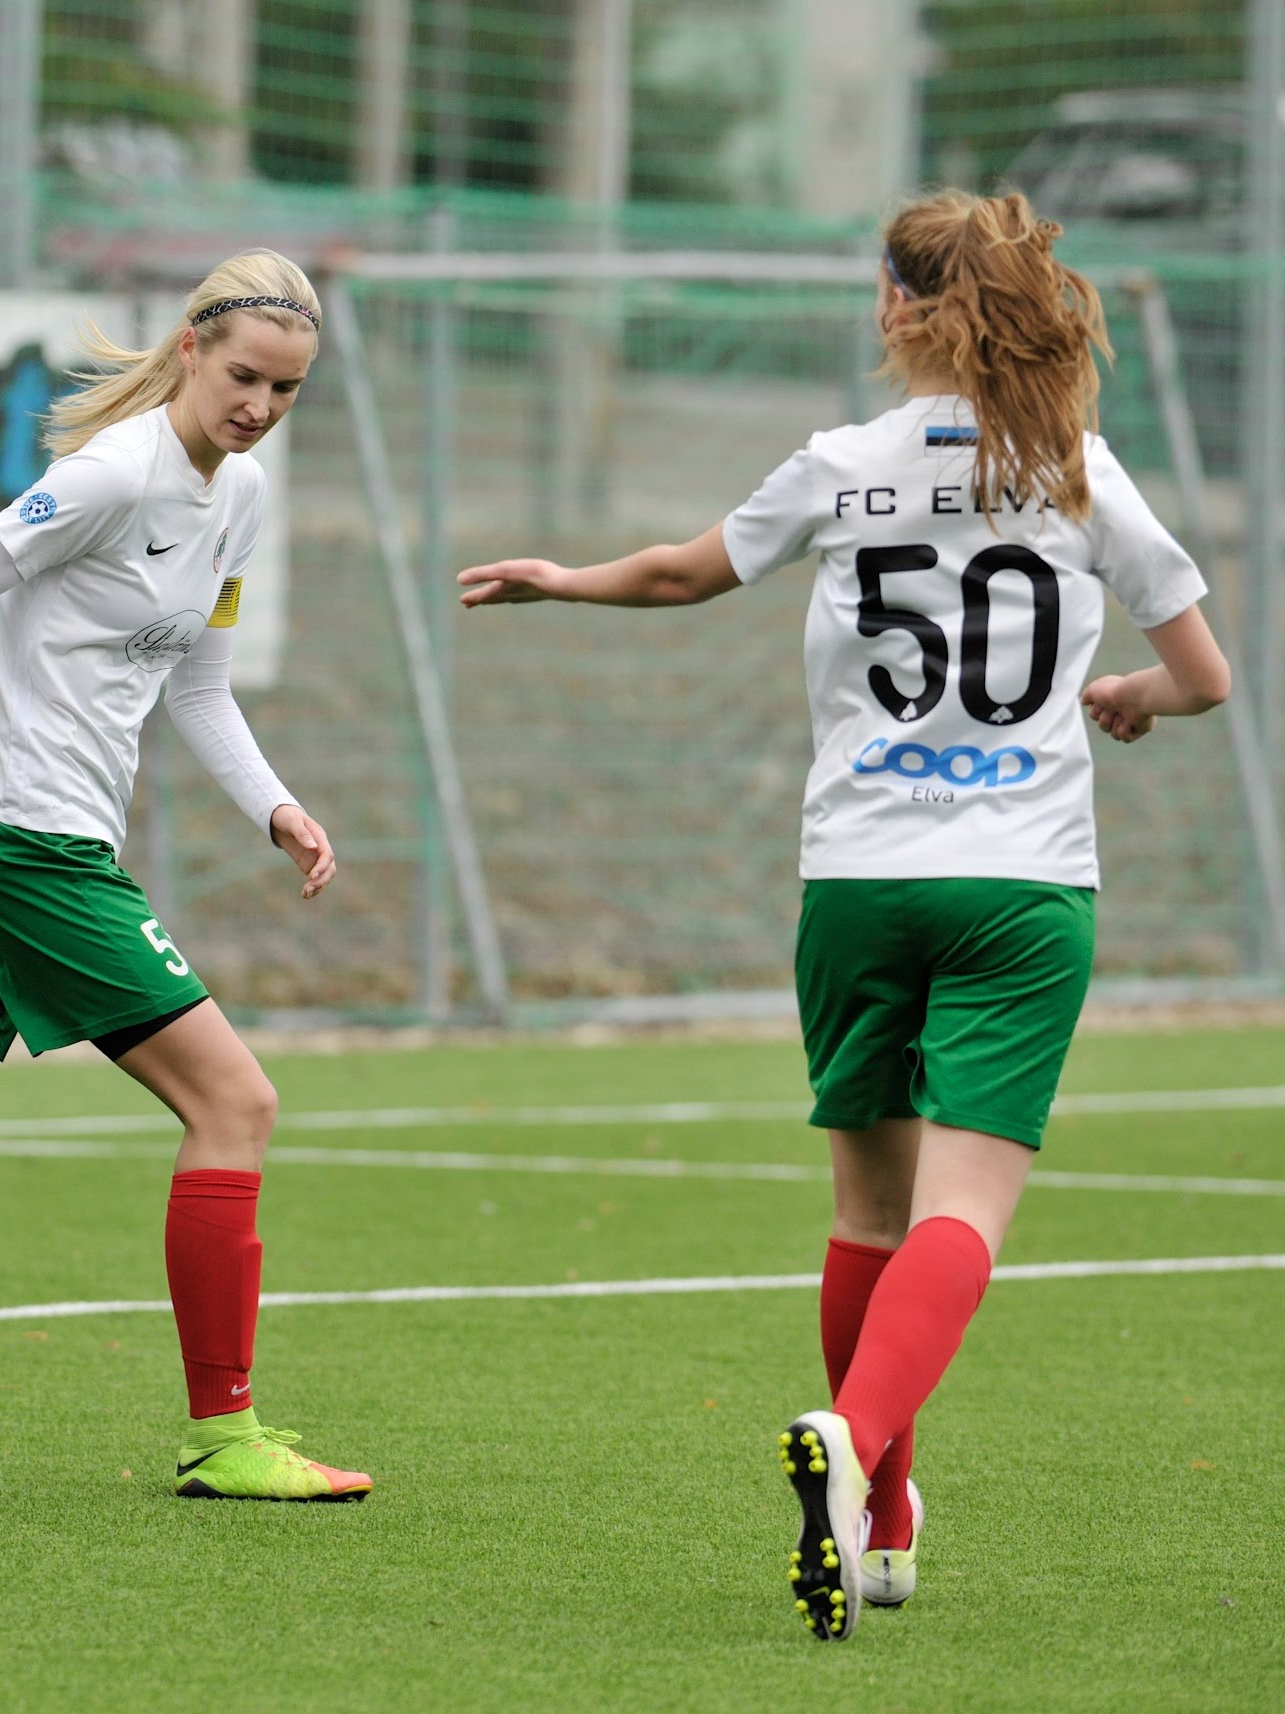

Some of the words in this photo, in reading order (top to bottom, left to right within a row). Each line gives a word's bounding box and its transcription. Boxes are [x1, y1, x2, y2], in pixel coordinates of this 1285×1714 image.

[835, 487, 896, 518] FC
[856, 544, 1060, 726] 50
[911, 786, 955, 803] Elva
[140, 918, 189, 977] 5
